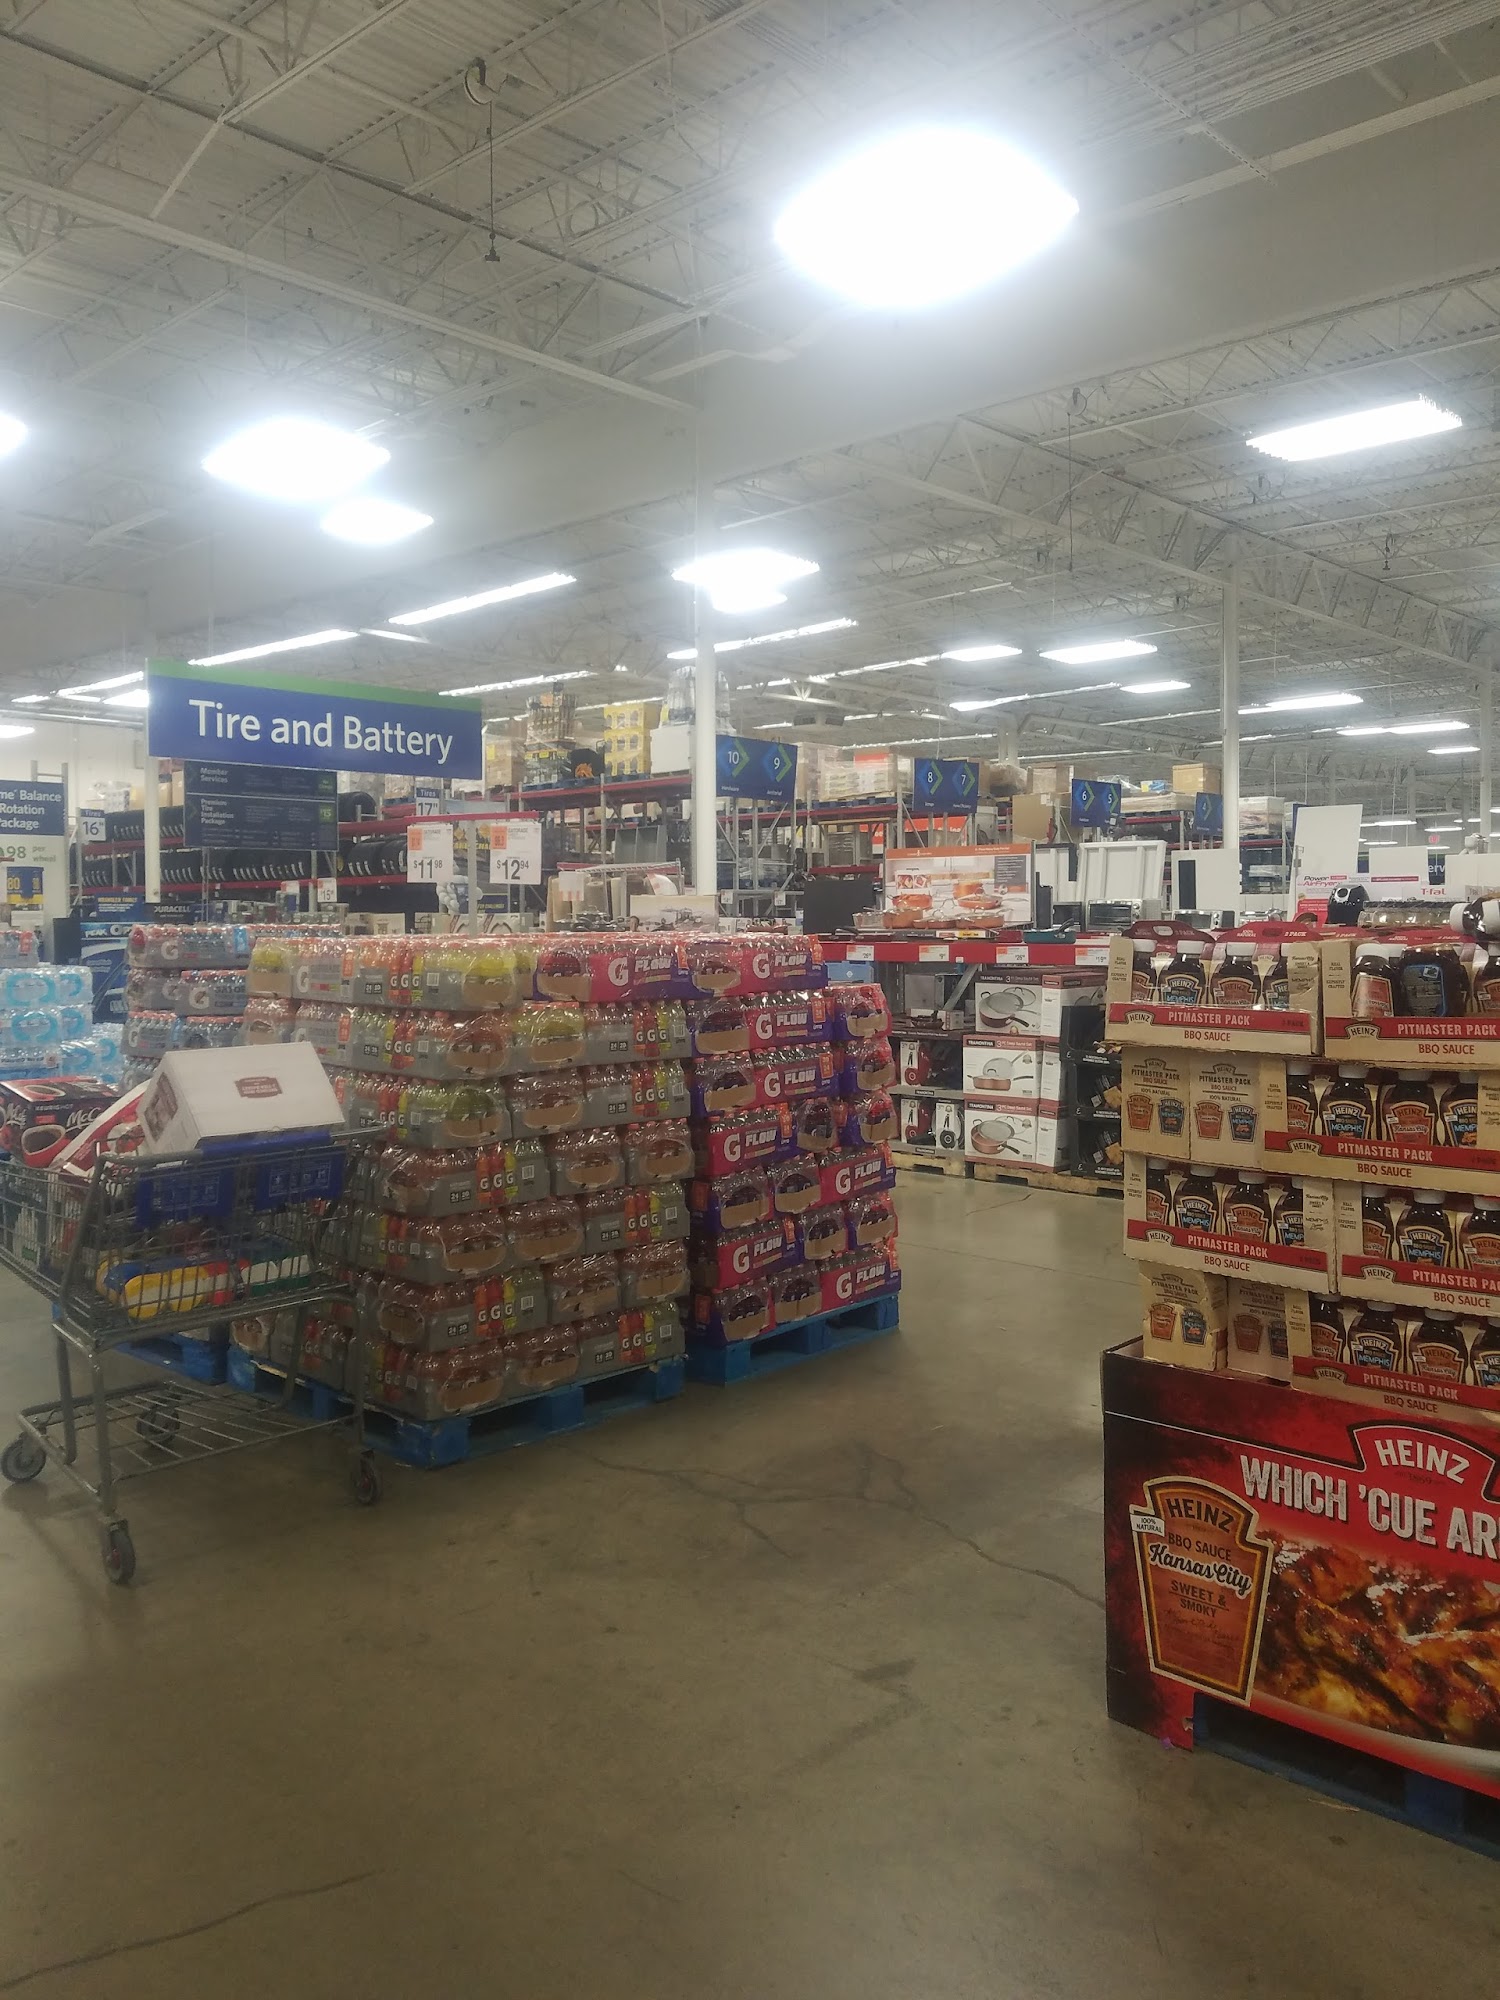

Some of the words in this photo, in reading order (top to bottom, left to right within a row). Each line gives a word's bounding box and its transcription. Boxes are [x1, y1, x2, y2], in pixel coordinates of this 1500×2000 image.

[189, 698, 261, 742] Tire
[271, 712, 332, 748] and
[344, 714, 453, 765] Battery
[728, 751, 739, 764] 10
[774, 758, 780, 769] 9
[201, 775, 228, 783] Services
[928, 772, 933, 782] 8
[961, 775, 966, 785] 7
[20, 790, 61, 801] Balance
[1082, 792, 1087, 801] 6
[1108, 795, 1112, 803] 5
[0, 818, 39, 830] ackage
[608, 958, 629, 987] G
[634, 957, 671, 973] FLOW
[752, 953, 771, 979] G
[774, 953, 807, 967] FLOW
[1171, 980, 1193, 988] HEINZ
[1130, 1013, 1150, 1022] HEINZ
[1168, 1011, 1222, 1024] PITMASTER
[1225, 1015, 1250, 1025] PACK
[756, 1013, 773, 1040] G
[776, 1012, 808, 1026] FLOW
[1351, 1025, 1375, 1036] HEINZ
[1398, 1024, 1462, 1035] PITMASTER
[1466, 1024, 1497, 1035] PACK
[636, 1031, 643, 1042] G
[647, 1030, 656, 1041] G
[659, 1030, 667, 1040] G
[1184, 1030, 1201, 1040] BBQ
[1204, 1031, 1231, 1042] SAUCE
[1419, 1044, 1439, 1054] BBQ
[1443, 1044, 1475, 1054] SAUCE
[1131, 1069, 1163, 1079] PITMASTER
[1165, 1072, 1180, 1080] PACK
[1199, 1076, 1233, 1085] PITMASTER
[764, 1072, 781, 1098] G
[784, 1069, 815, 1084] FLOW
[635, 1091, 642, 1102] G
[646, 1089, 655, 1101] G
[657, 1089, 665, 1099] G
[1335, 1107, 1359, 1116] HEINZ
[1398, 1107, 1421, 1117] HEINZ
[1332, 1123, 1363, 1133] MEMPHIS
[723, 1133, 740, 1162] G
[745, 1129, 777, 1147] FLOW
[1293, 1142, 1317, 1152] HEINZ
[1337, 1142, 1400, 1158] PITMASTER
[1404, 1149, 1433, 1161] PACK
[1358, 1163, 1378, 1174] BBQ
[1381, 1166, 1412, 1178] SAUCE
[479, 1177, 489, 1190] G
[493, 1173, 503, 1188] G
[506, 1173, 514, 1184] G
[836, 1167, 851, 1195] G
[854, 1159, 881, 1179] FLOW
[1185, 1201, 1208, 1211] HEINZ
[627, 1217, 636, 1229] G
[639, 1214, 648, 1228] G
[650, 1212, 658, 1224] G
[1236, 1210, 1258, 1219] HEINZ
[1182, 1216, 1210, 1226] MEMPHIS
[1149, 1234, 1170, 1243] HEINZ
[1412, 1232, 1437, 1242] HEINZ
[1187, 1234, 1240, 1253] PITMASTER
[1244, 1244, 1268, 1259] PACK
[1477, 1239, 1500, 1250] HEINZ
[733, 1244, 749, 1273] G
[754, 1236, 783, 1256] FLOW
[1408, 1249, 1442, 1260] MEMPHIS
[1204, 1255, 1222, 1266] BBQ
[1224, 1258, 1250, 1272] SAUCE
[1367, 1269, 1391, 1279] HEINZ
[1412, 1270, 1477, 1288] PITMASTER
[836, 1271, 852, 1300] G
[856, 1264, 885, 1283] FLOW
[1433, 1291, 1455, 1304] BBQ
[1458, 1295, 1490, 1308] SAUCE
[478, 1310, 487, 1322] G
[490, 1305, 501, 1320] G
[1363, 1338, 1388, 1349] HEINZ
[1358, 1355, 1390, 1366] MEMPHIS
[1318, 1370, 1343, 1381] HEINZ
[1363, 1373, 1425, 1394] PITMASTER
[1429, 1386, 1458, 1400] PACK
[1384, 1395, 1404, 1407] BBQ
[1407, 1400, 1438, 1413] SAUCE
[1374, 1439, 1470, 1485] HEINZ
[1240, 1454, 1348, 1522] WHICH
[1446, 1507, 1500, 1560] AR
[1166, 1498, 1235, 1533] HEINZ
[1136, 1524, 1162, 1533] NATURAL
[1168, 1532, 1192, 1550] BBQ
[1195, 1541, 1232, 1561] SAUCE
[1171, 1580, 1214, 1600] SWEET
[1218, 1594, 1227, 1607] &
[1180, 1599, 1217, 1618] SMOKY
